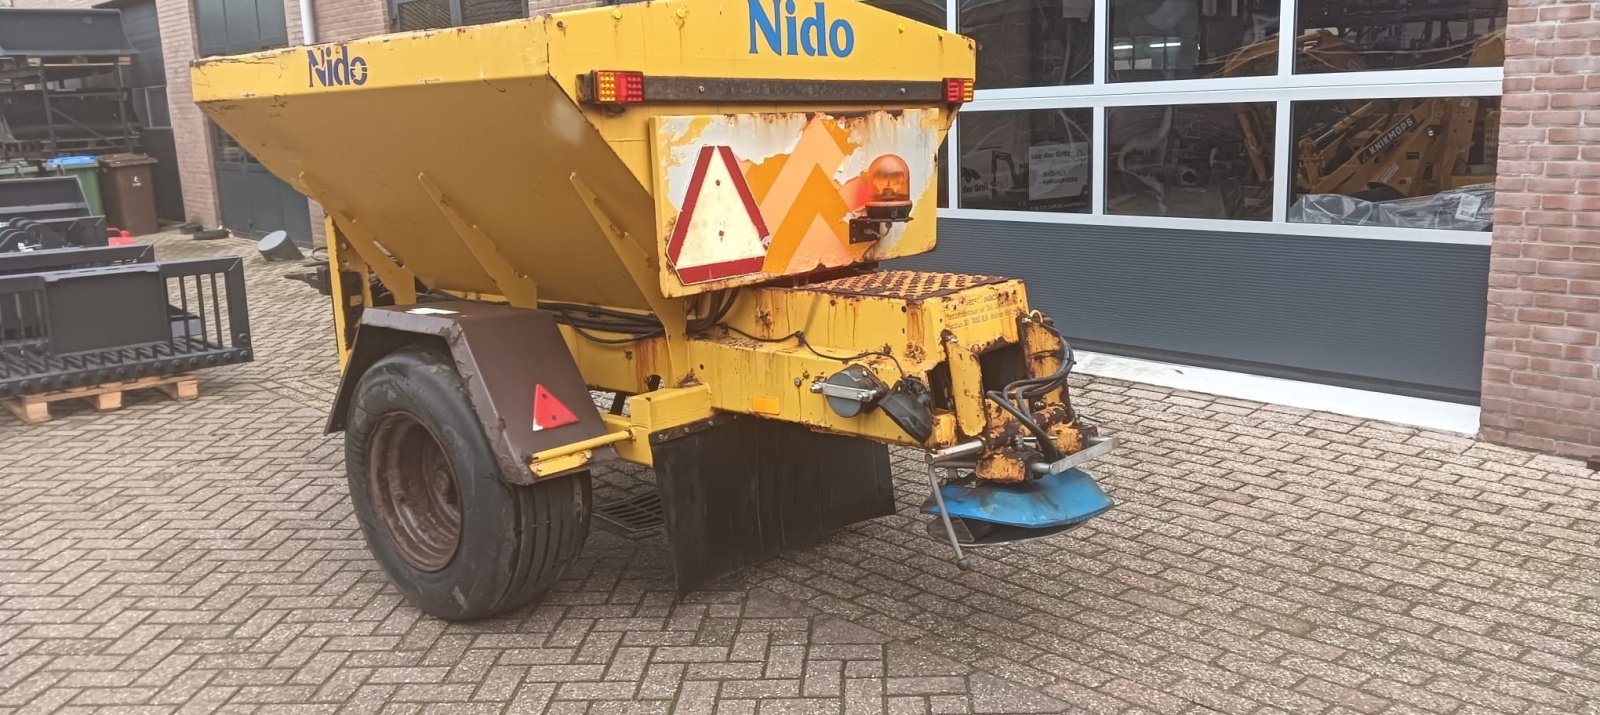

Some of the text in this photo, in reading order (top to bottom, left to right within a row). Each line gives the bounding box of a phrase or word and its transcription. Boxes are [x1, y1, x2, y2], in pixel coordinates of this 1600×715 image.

[748, 0, 854, 58] Nido
[307, 45, 368, 87] Nido
[1369, 117, 1413, 155] KNIKMOPS
